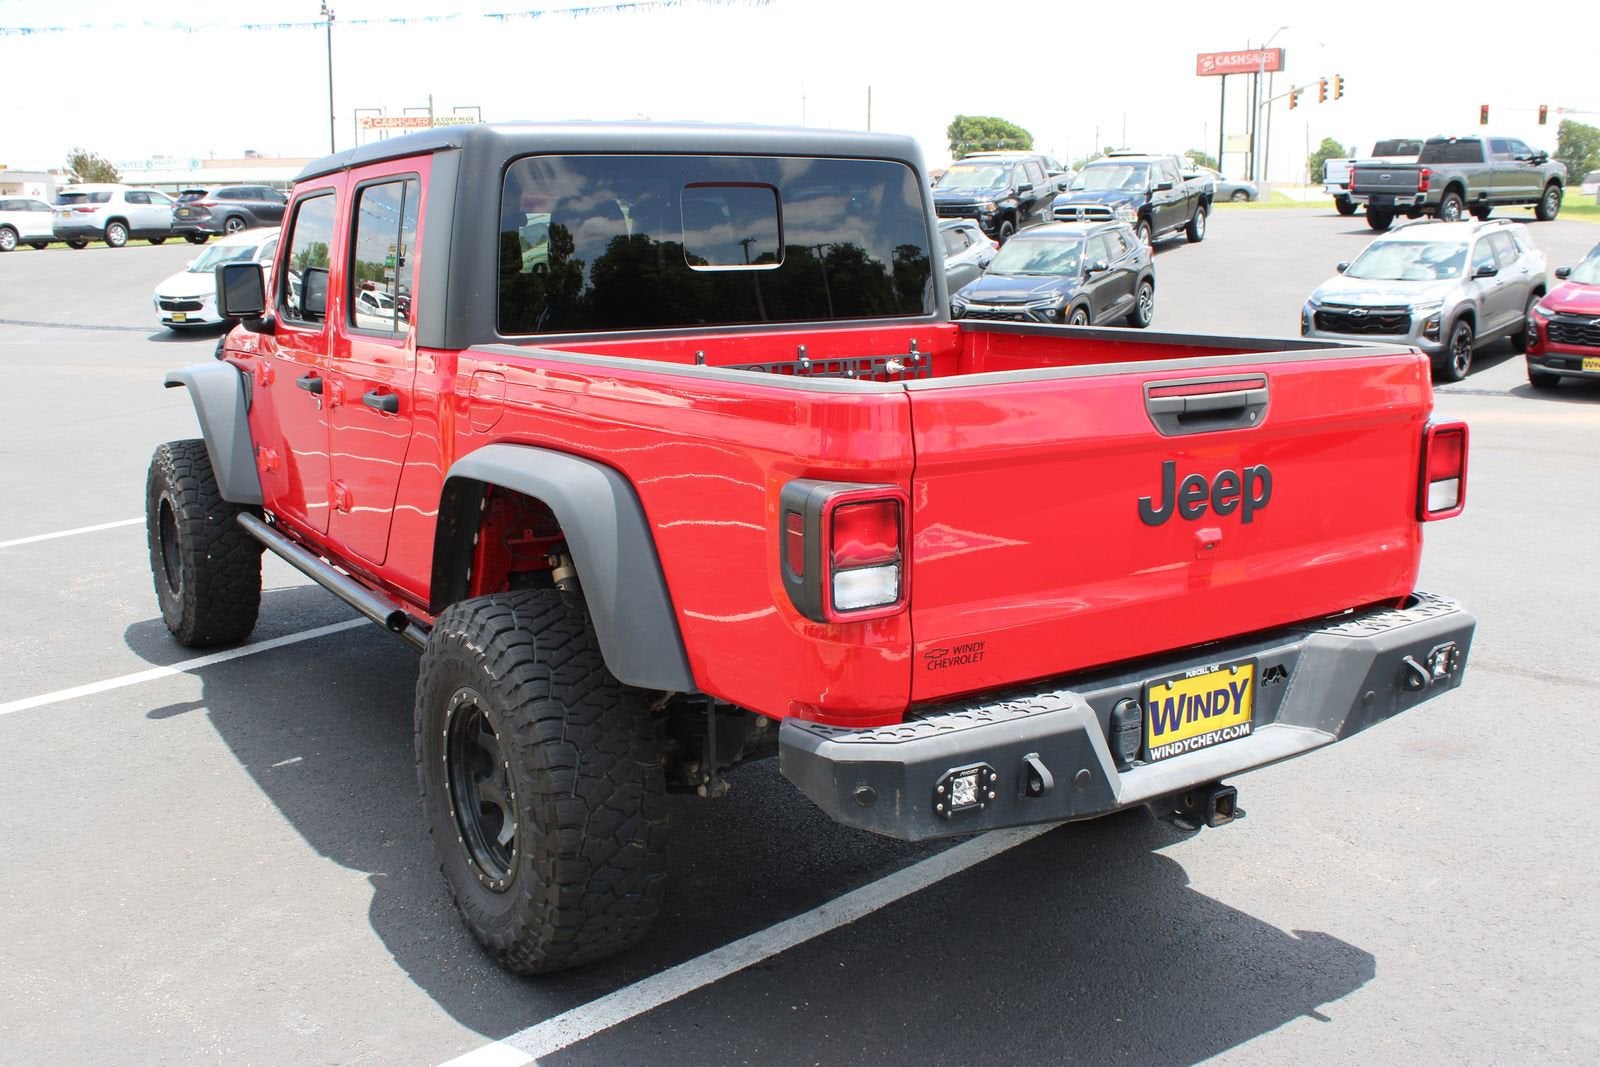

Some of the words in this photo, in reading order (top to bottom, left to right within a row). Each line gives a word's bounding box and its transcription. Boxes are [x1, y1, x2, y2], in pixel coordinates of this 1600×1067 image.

[1215, 52, 1276, 66] CASHSAVER
[1138, 460, 1272, 527] Jeep
[953, 641, 985, 655] WINDY
[927, 651, 985, 671] CHEVROLET
[1210, 665, 1220, 673] OK
[1149, 678, 1250, 736] WINDY
[1150, 723, 1250, 760] WINDYCHEV.COM
